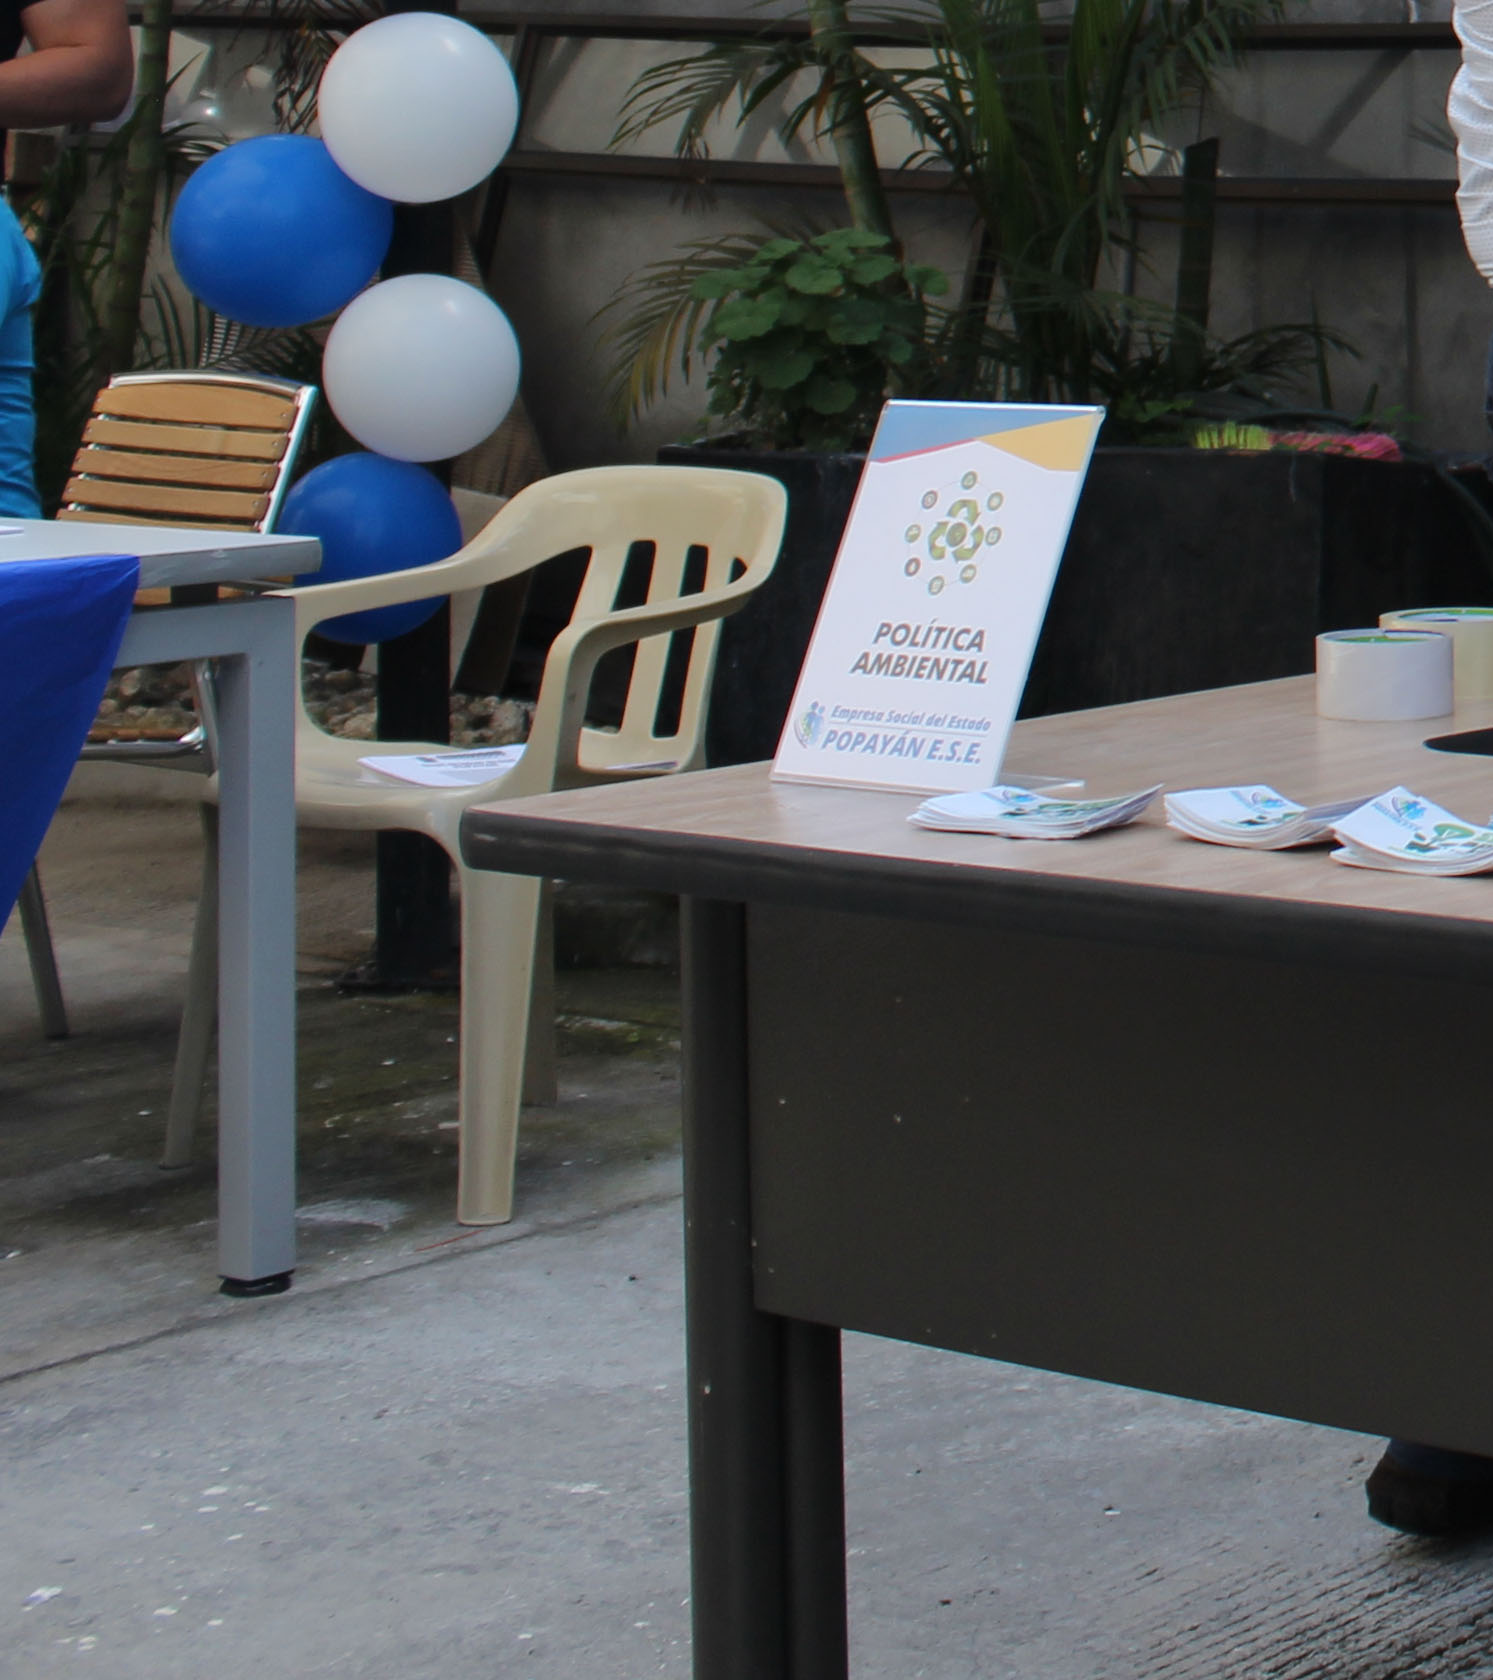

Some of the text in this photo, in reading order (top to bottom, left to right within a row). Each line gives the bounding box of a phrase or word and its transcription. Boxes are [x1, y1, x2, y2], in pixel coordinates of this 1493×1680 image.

[872, 619, 986, 653] POLÍTICA
[849, 651, 988, 684] AMBIENTAL
[831, 704, 992, 732] Empresa Social del Estado
[821, 729, 982, 765] POPAYÁN E.S.E.
